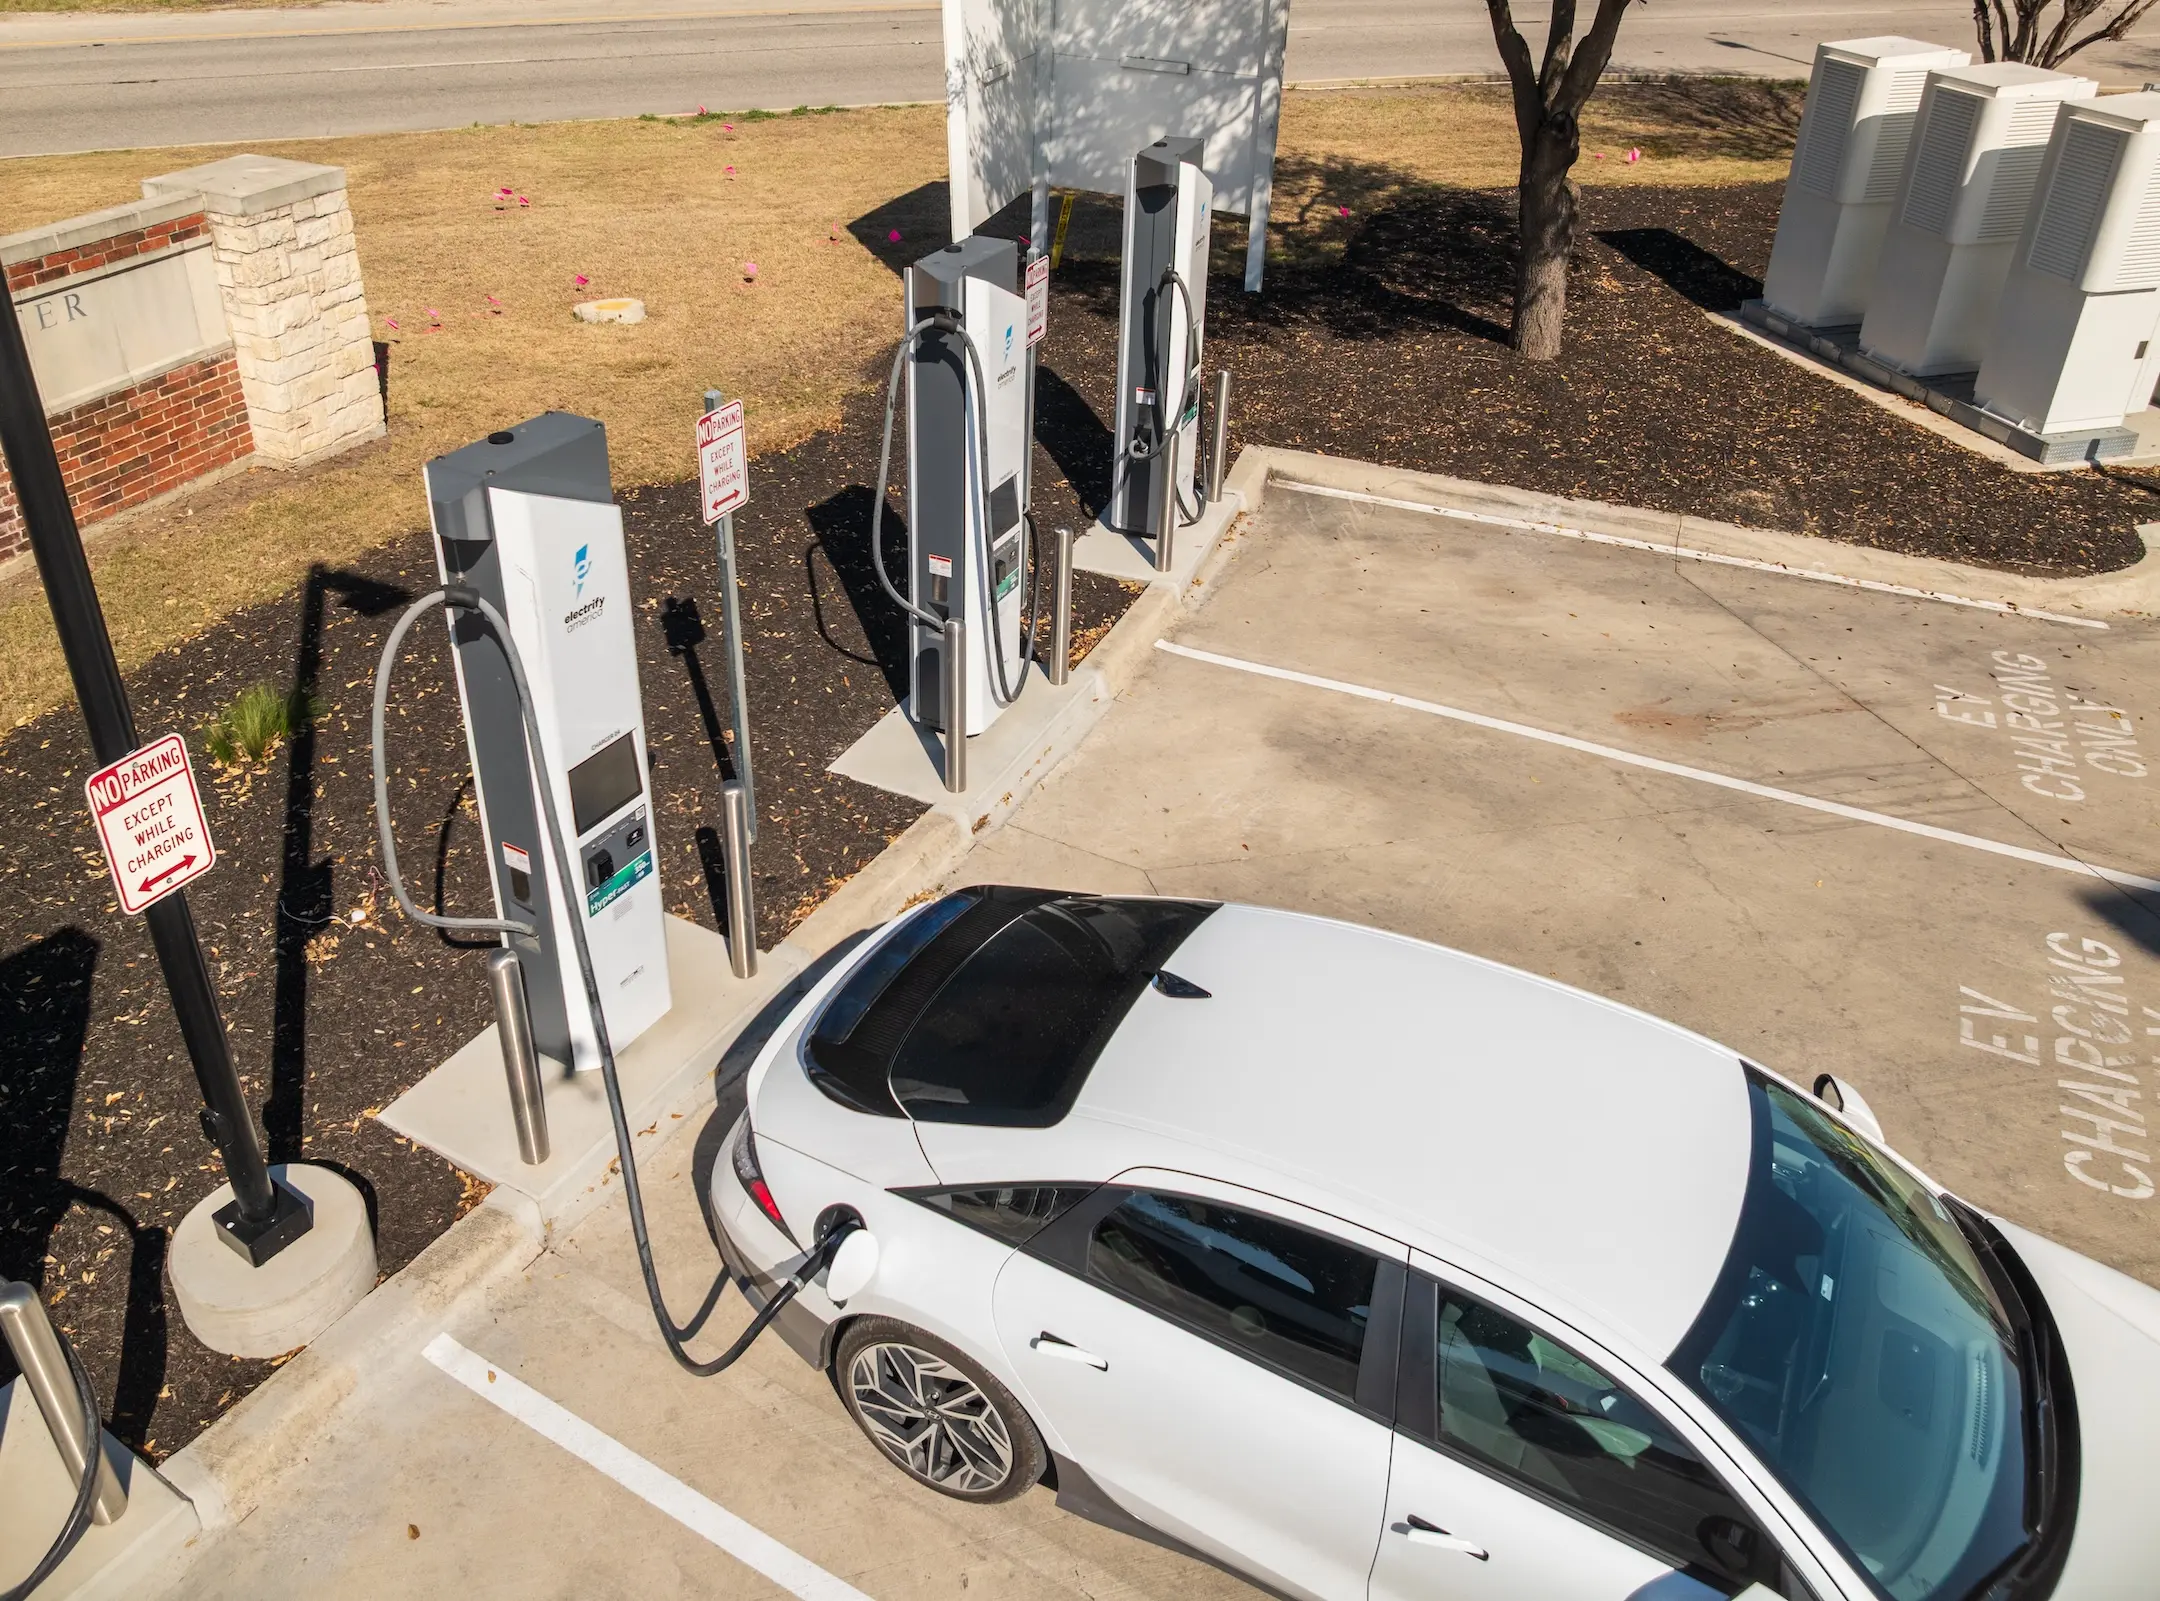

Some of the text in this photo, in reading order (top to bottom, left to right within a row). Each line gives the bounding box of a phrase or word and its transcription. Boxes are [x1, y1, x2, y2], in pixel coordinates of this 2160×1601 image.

[15, 293, 88, 331] ER
[699, 409, 741, 445] NO PARKING
[710, 442, 735, 463] EXCEPT
[713, 458, 734, 476] WHILE
[708, 469, 741, 495] CHARGING
[564, 596, 605, 624] electrify
[566, 608, 604, 634] america
[1933, 683, 1998, 729] EV
[1991, 650, 2086, 801] CHARGING
[2065, 693, 2149, 778] ONLY
[90, 747, 181, 812] NO PARKING
[124, 792, 174, 831] EXCEPT
[127, 826, 194, 874] CHARGING
[134, 815, 176, 847] WHILE
[1959, 985, 2041, 1066] EV
[2046, 932, 2156, 1199] CHARGING
